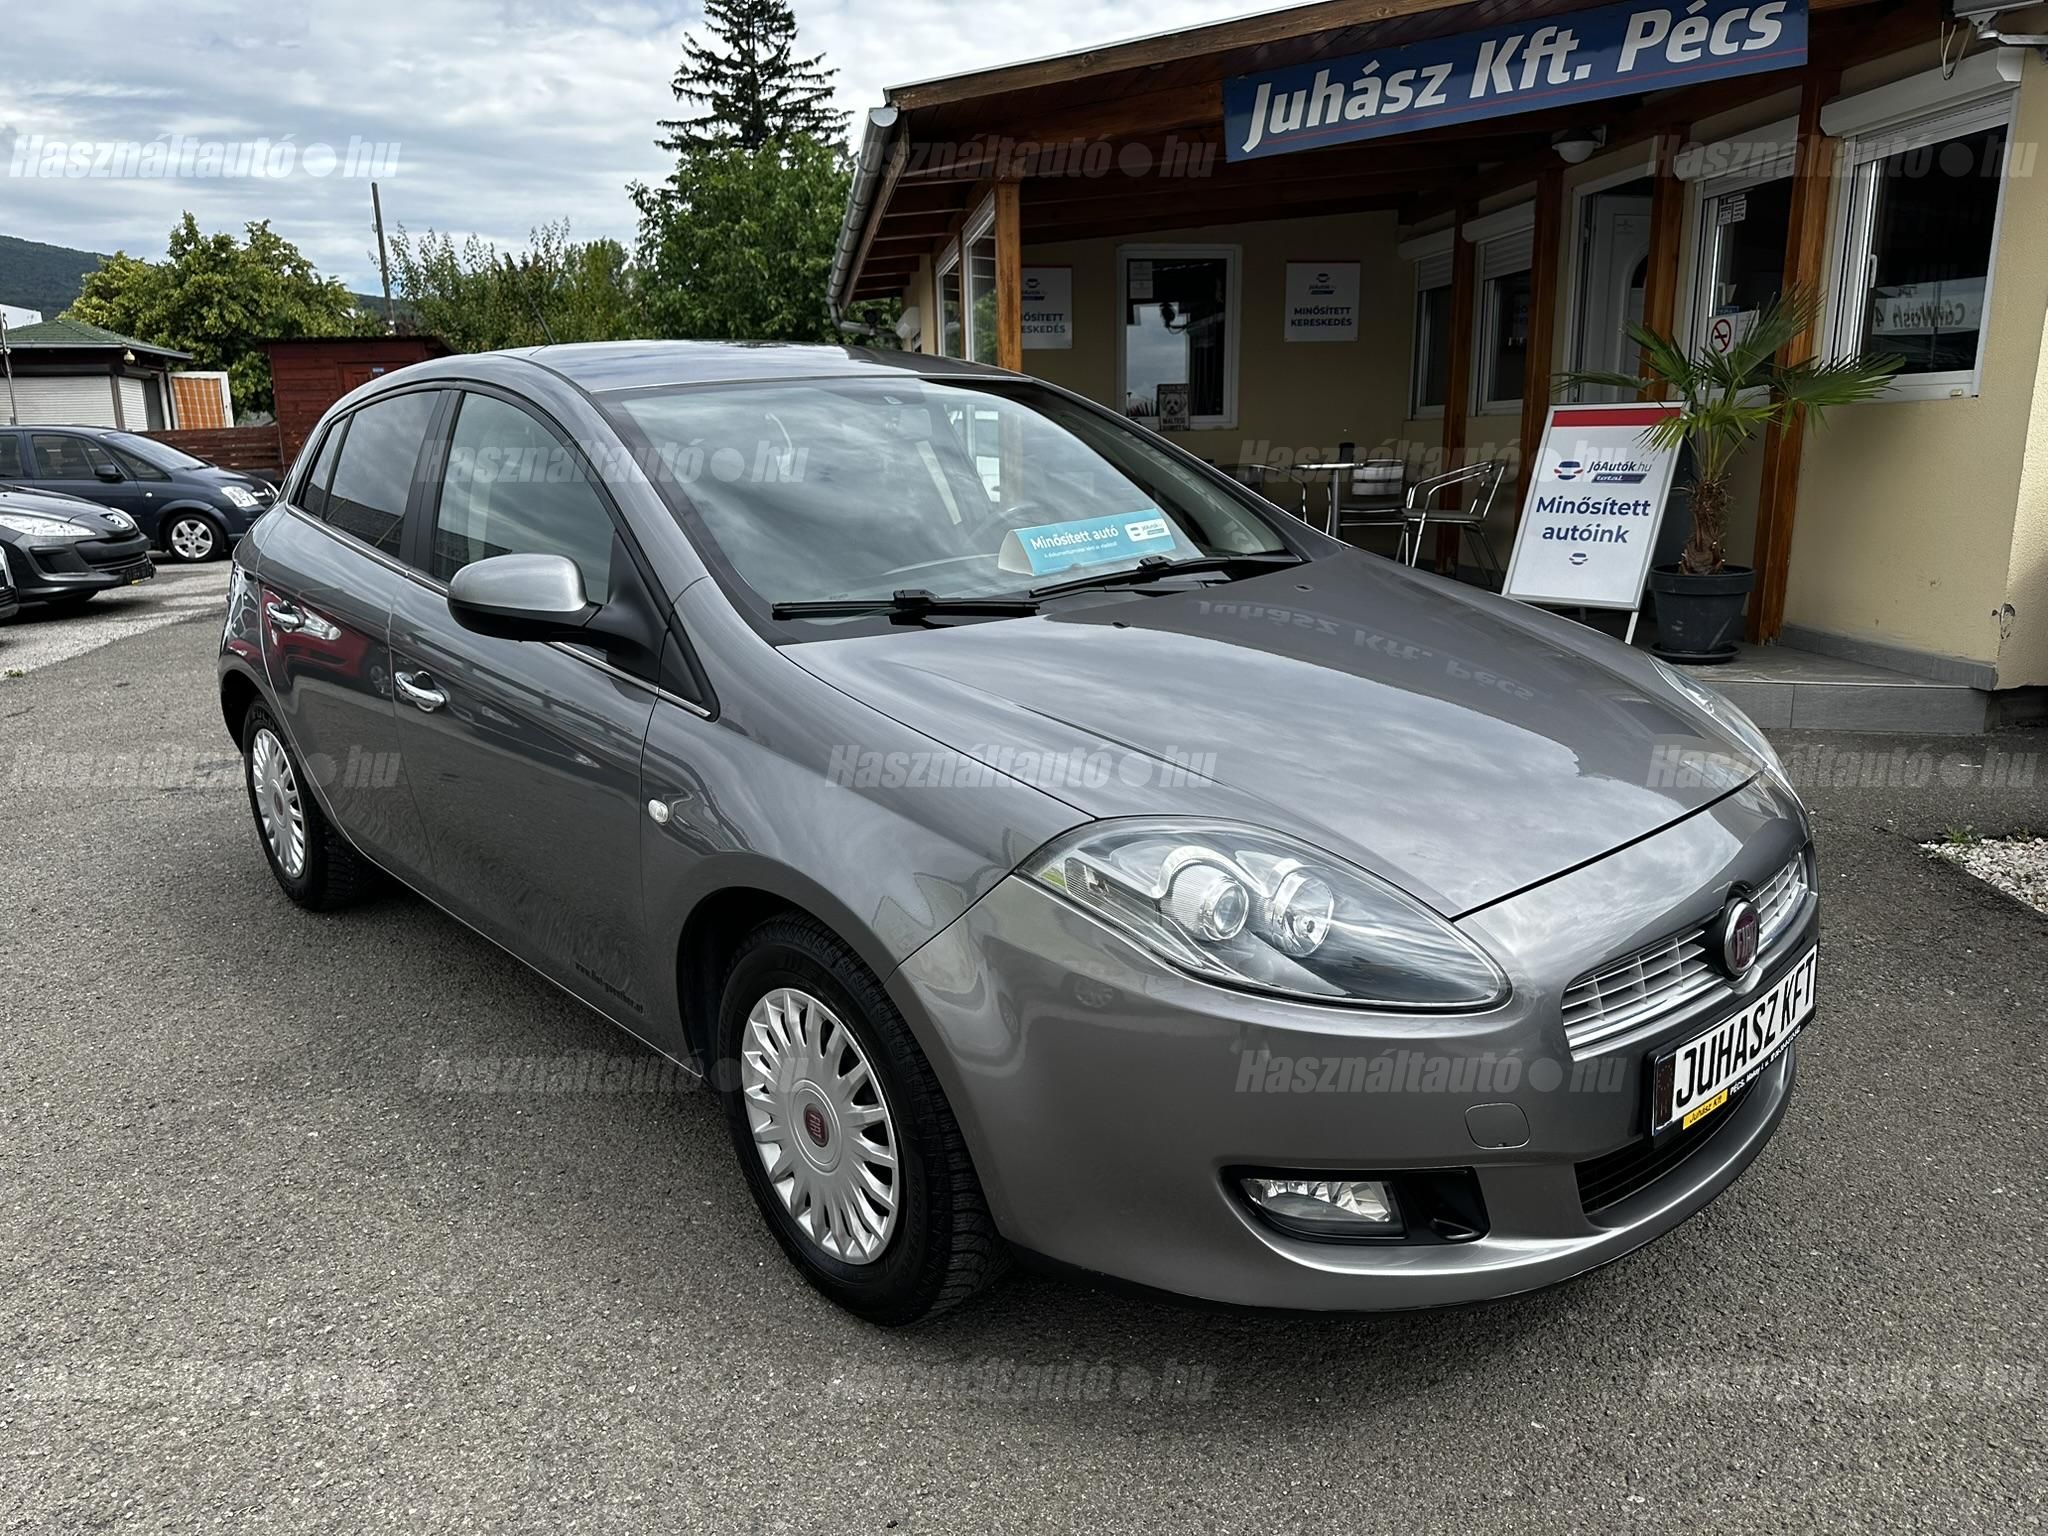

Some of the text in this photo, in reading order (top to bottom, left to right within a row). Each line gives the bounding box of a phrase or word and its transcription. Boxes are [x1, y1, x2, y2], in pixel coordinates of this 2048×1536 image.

[1242, 1, 1787, 153] Juhász Kft. Pécs
[1294, 304, 1352, 315] MINŐSÍTETT
[1290, 317, 1353, 327] KERESKEDÉS
[1586, 461, 1653, 474] JóAutók.hu
[1536, 495, 1651, 516] Minősített
[1030, 529, 1092, 551] Minősített
[1091, 524, 1120, 541] autó
[1542, 523, 1630, 543] autóink
[1676, 951, 1816, 1108] JUHASZ KFT
[809, 1113, 822, 1139] FIAT
